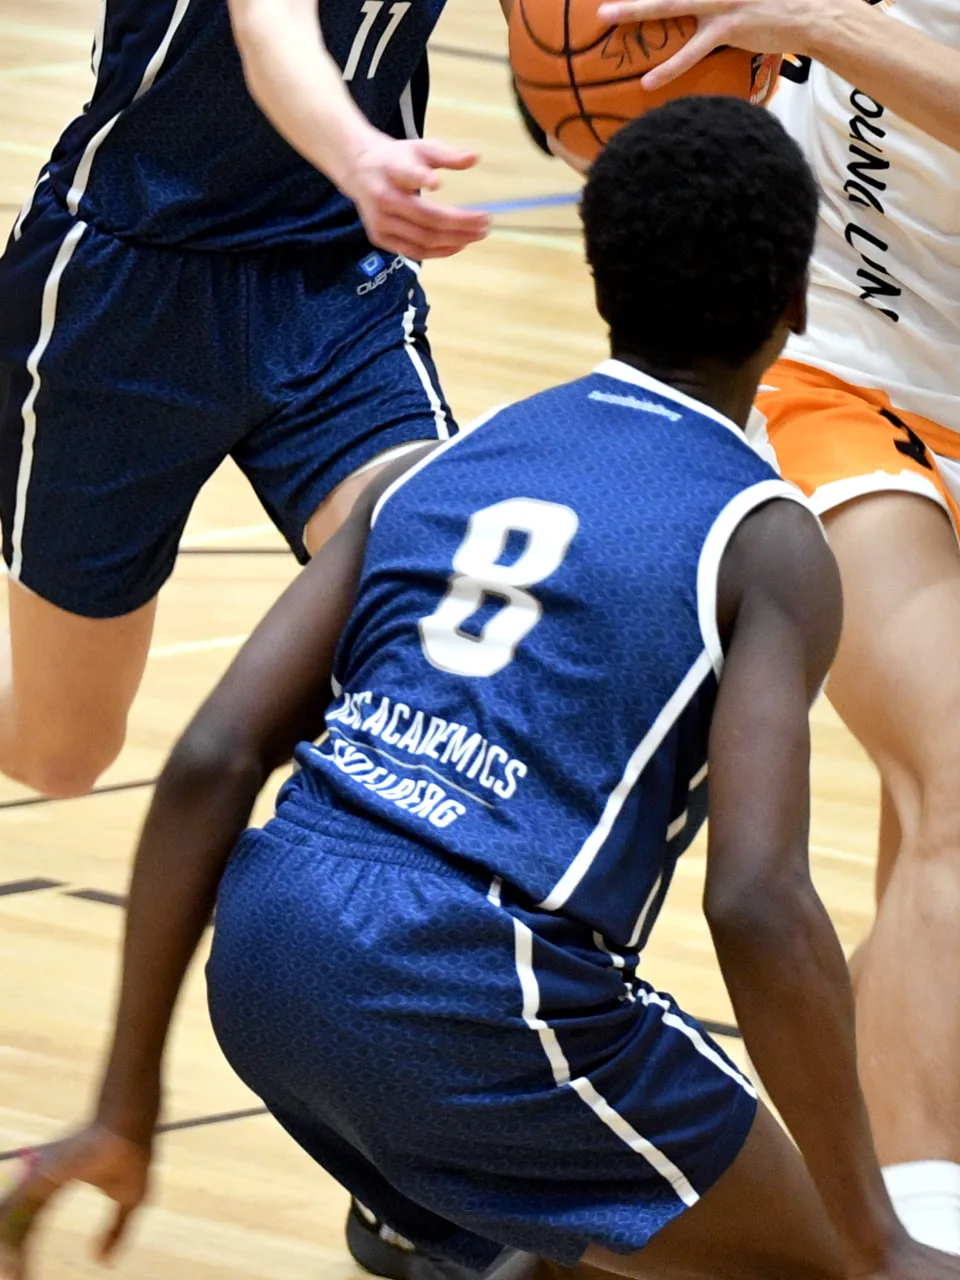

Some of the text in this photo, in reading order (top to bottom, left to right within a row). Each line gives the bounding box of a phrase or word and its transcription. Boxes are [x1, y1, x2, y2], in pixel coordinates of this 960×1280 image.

[343, 0, 412, 82] 11
[417, 496, 580, 678] 8
[361, 696, 528, 800] ACADEMICS
